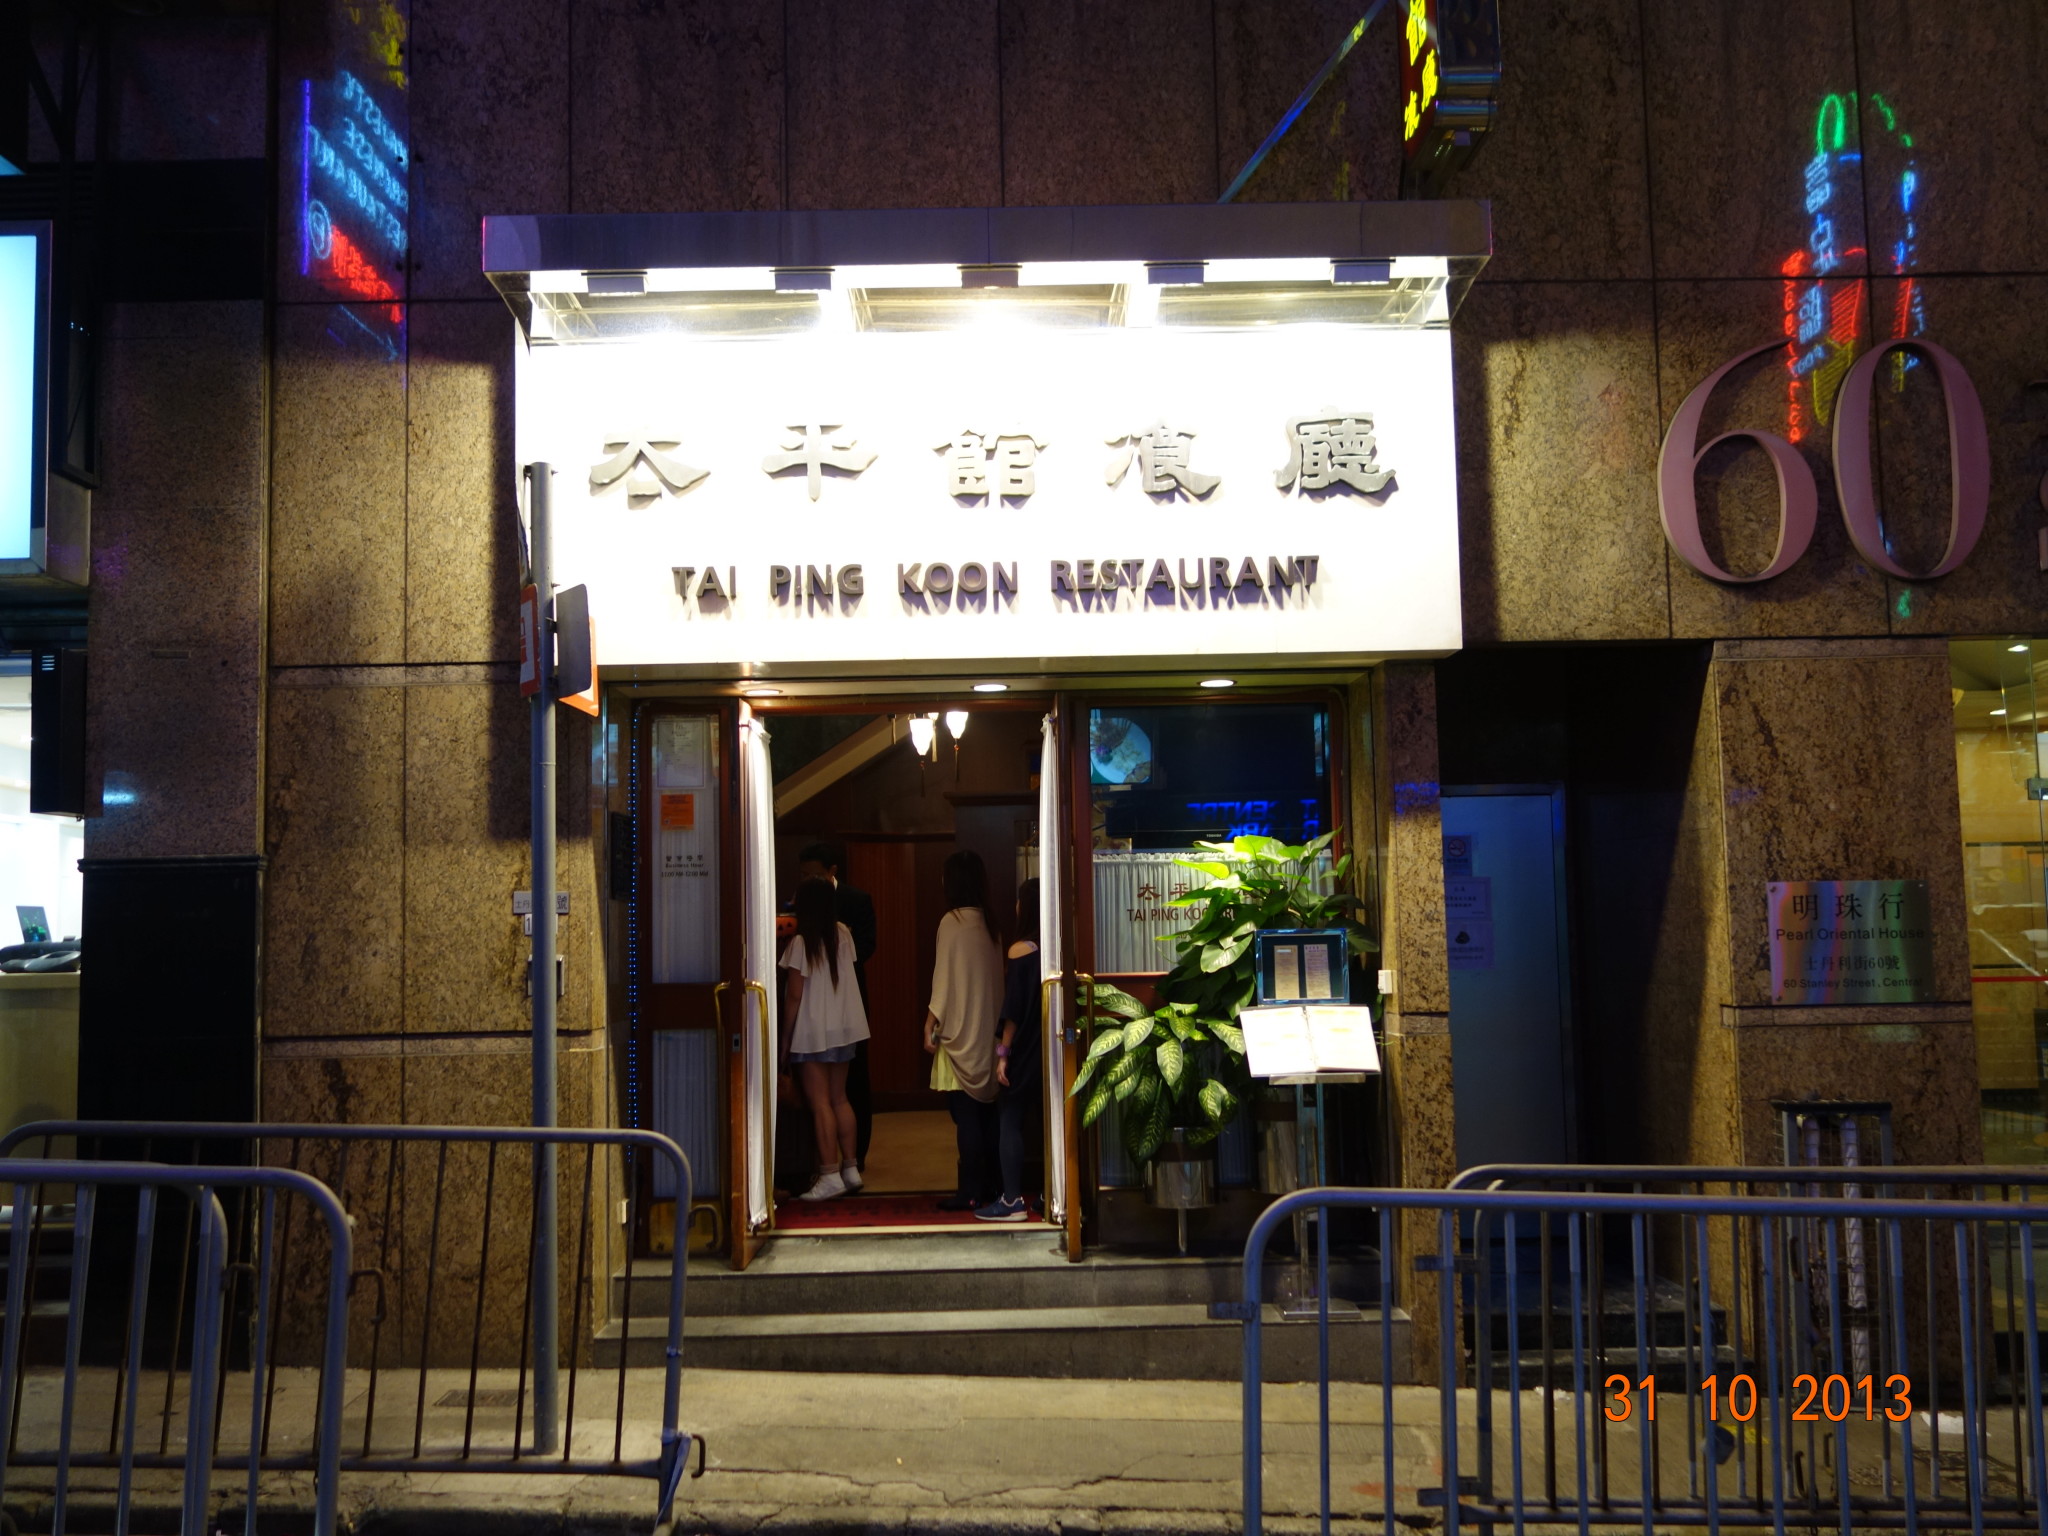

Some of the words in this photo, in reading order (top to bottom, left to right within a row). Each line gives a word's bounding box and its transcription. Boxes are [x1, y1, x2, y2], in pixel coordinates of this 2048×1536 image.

[1657, 337, 1990, 584] 60
[671, 564, 737, 600] TAI
[769, 563, 865, 599] PING
[897, 561, 1018, 595] KOON
[1050, 555, 1320, 594] RESTAURANT
[1127, 909, 1146, 921] TAI
[1151, 908, 1179, 921] PING
[1792, 893, 1905, 921] 明珠行
[1776, 928, 1813, 941] Pearl
[1817, 927, 1875, 941] Oriental
[1878, 927, 1926, 940] House
[1783, 978, 1798, 989] 60
[1800, 977, 1840, 990] Stanley
[1883, 976, 1924, 988] Central
